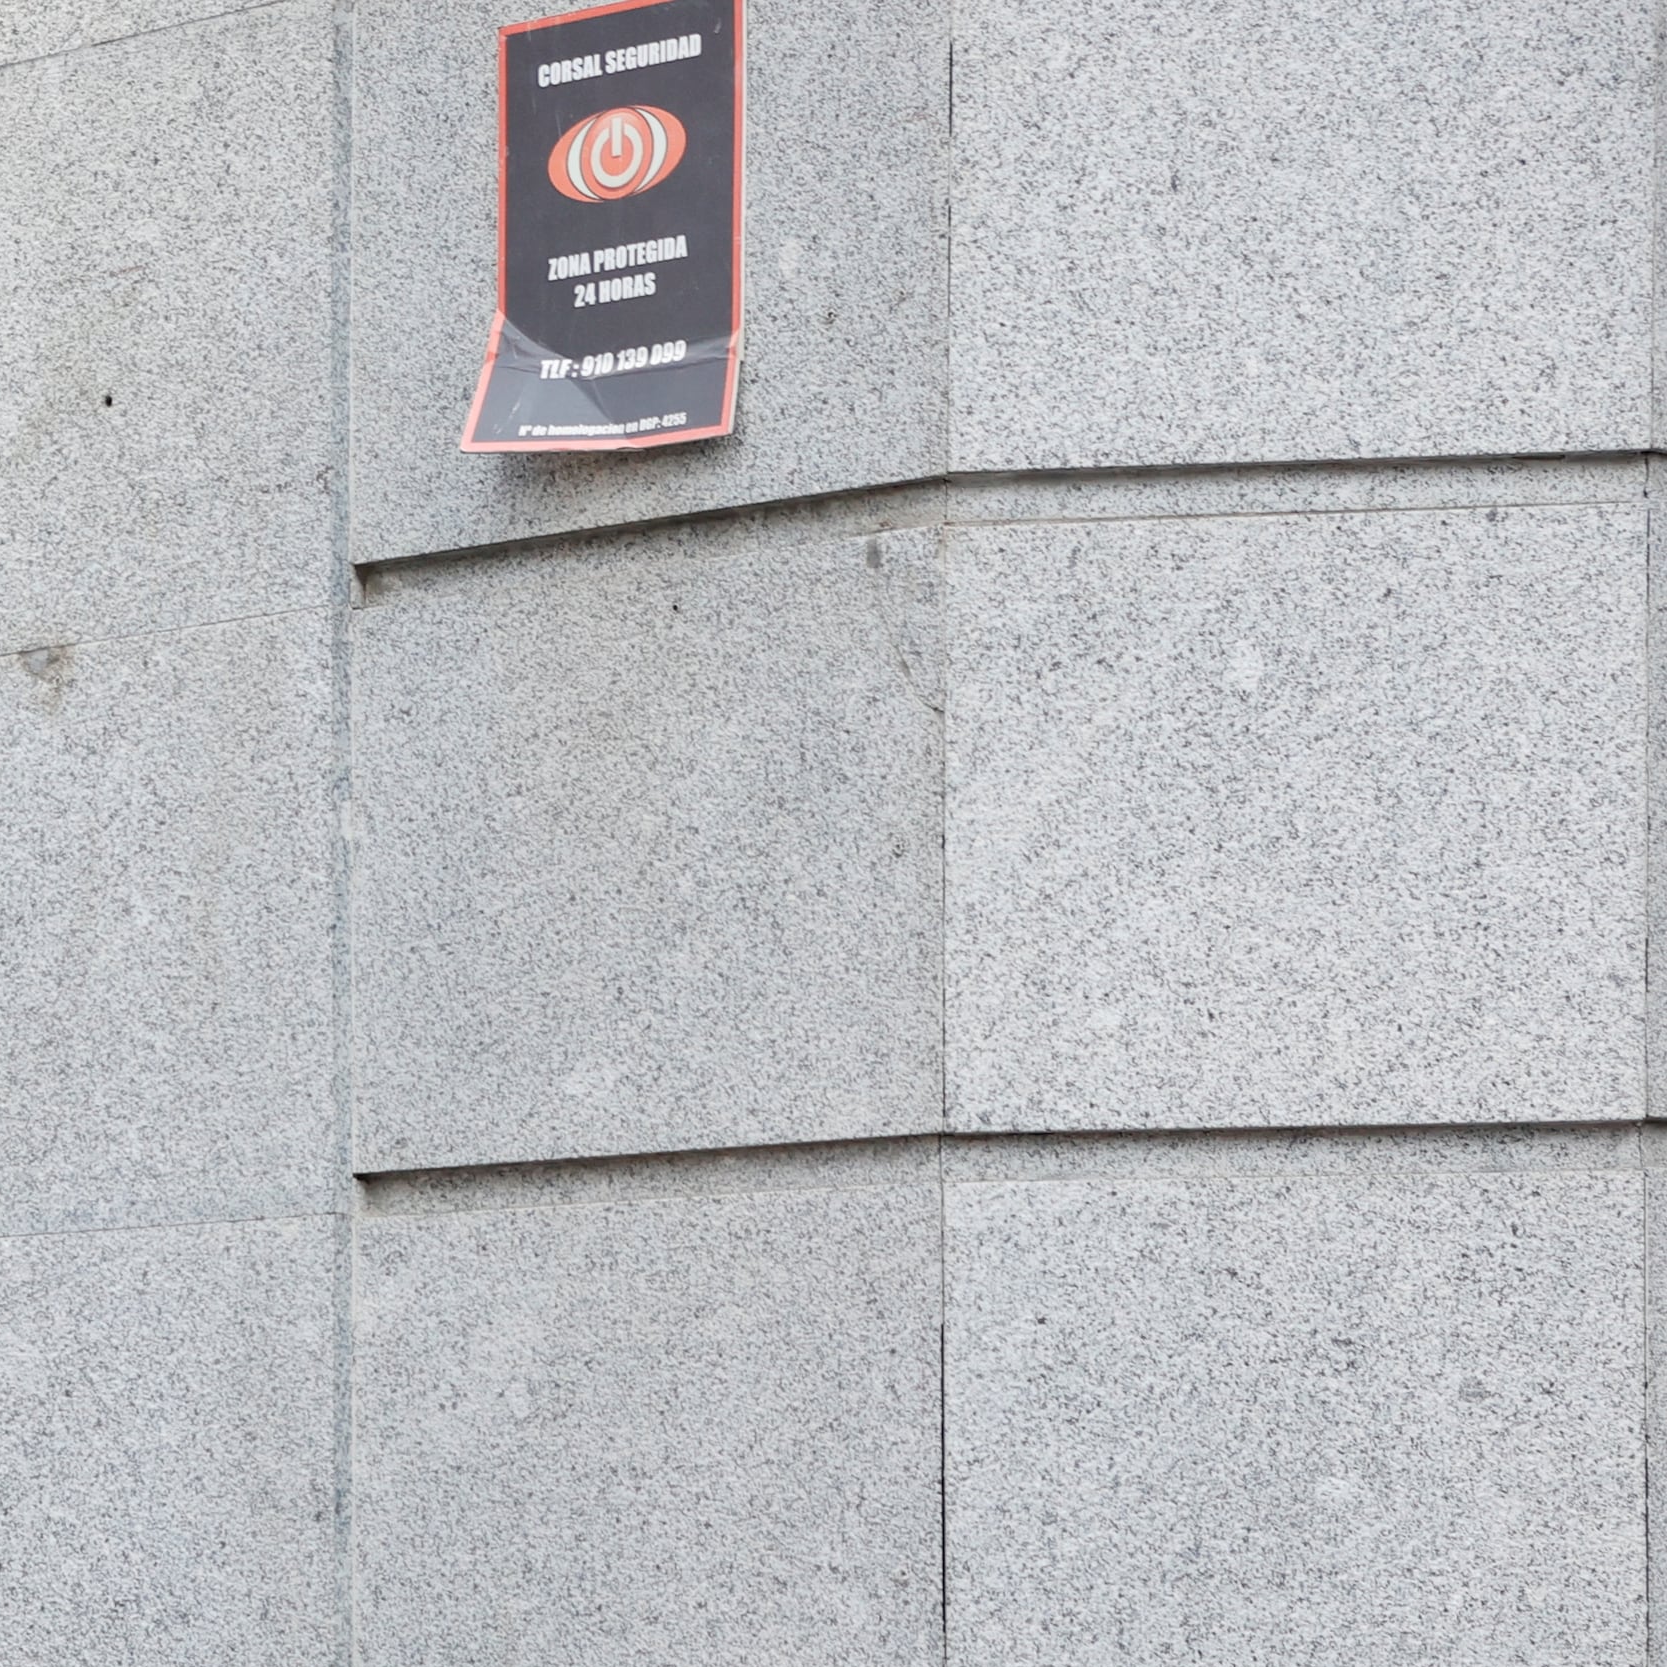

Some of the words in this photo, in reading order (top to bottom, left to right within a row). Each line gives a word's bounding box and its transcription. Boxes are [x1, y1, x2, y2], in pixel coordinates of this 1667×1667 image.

[538, 54, 602, 88] CORSAL
[605, 33, 703, 74] SEGURIDAD
[548, 252, 592, 281] ZONA
[593, 235, 688, 273] PROTEGIDA
[574, 284, 597, 308] 24
[598, 272, 657, 303] HORAS
[580, 352, 614, 378] 910
[617, 346, 648, 371] 139
[531, 424, 547, 436] de
[661, 412, 687, 426] 4255
